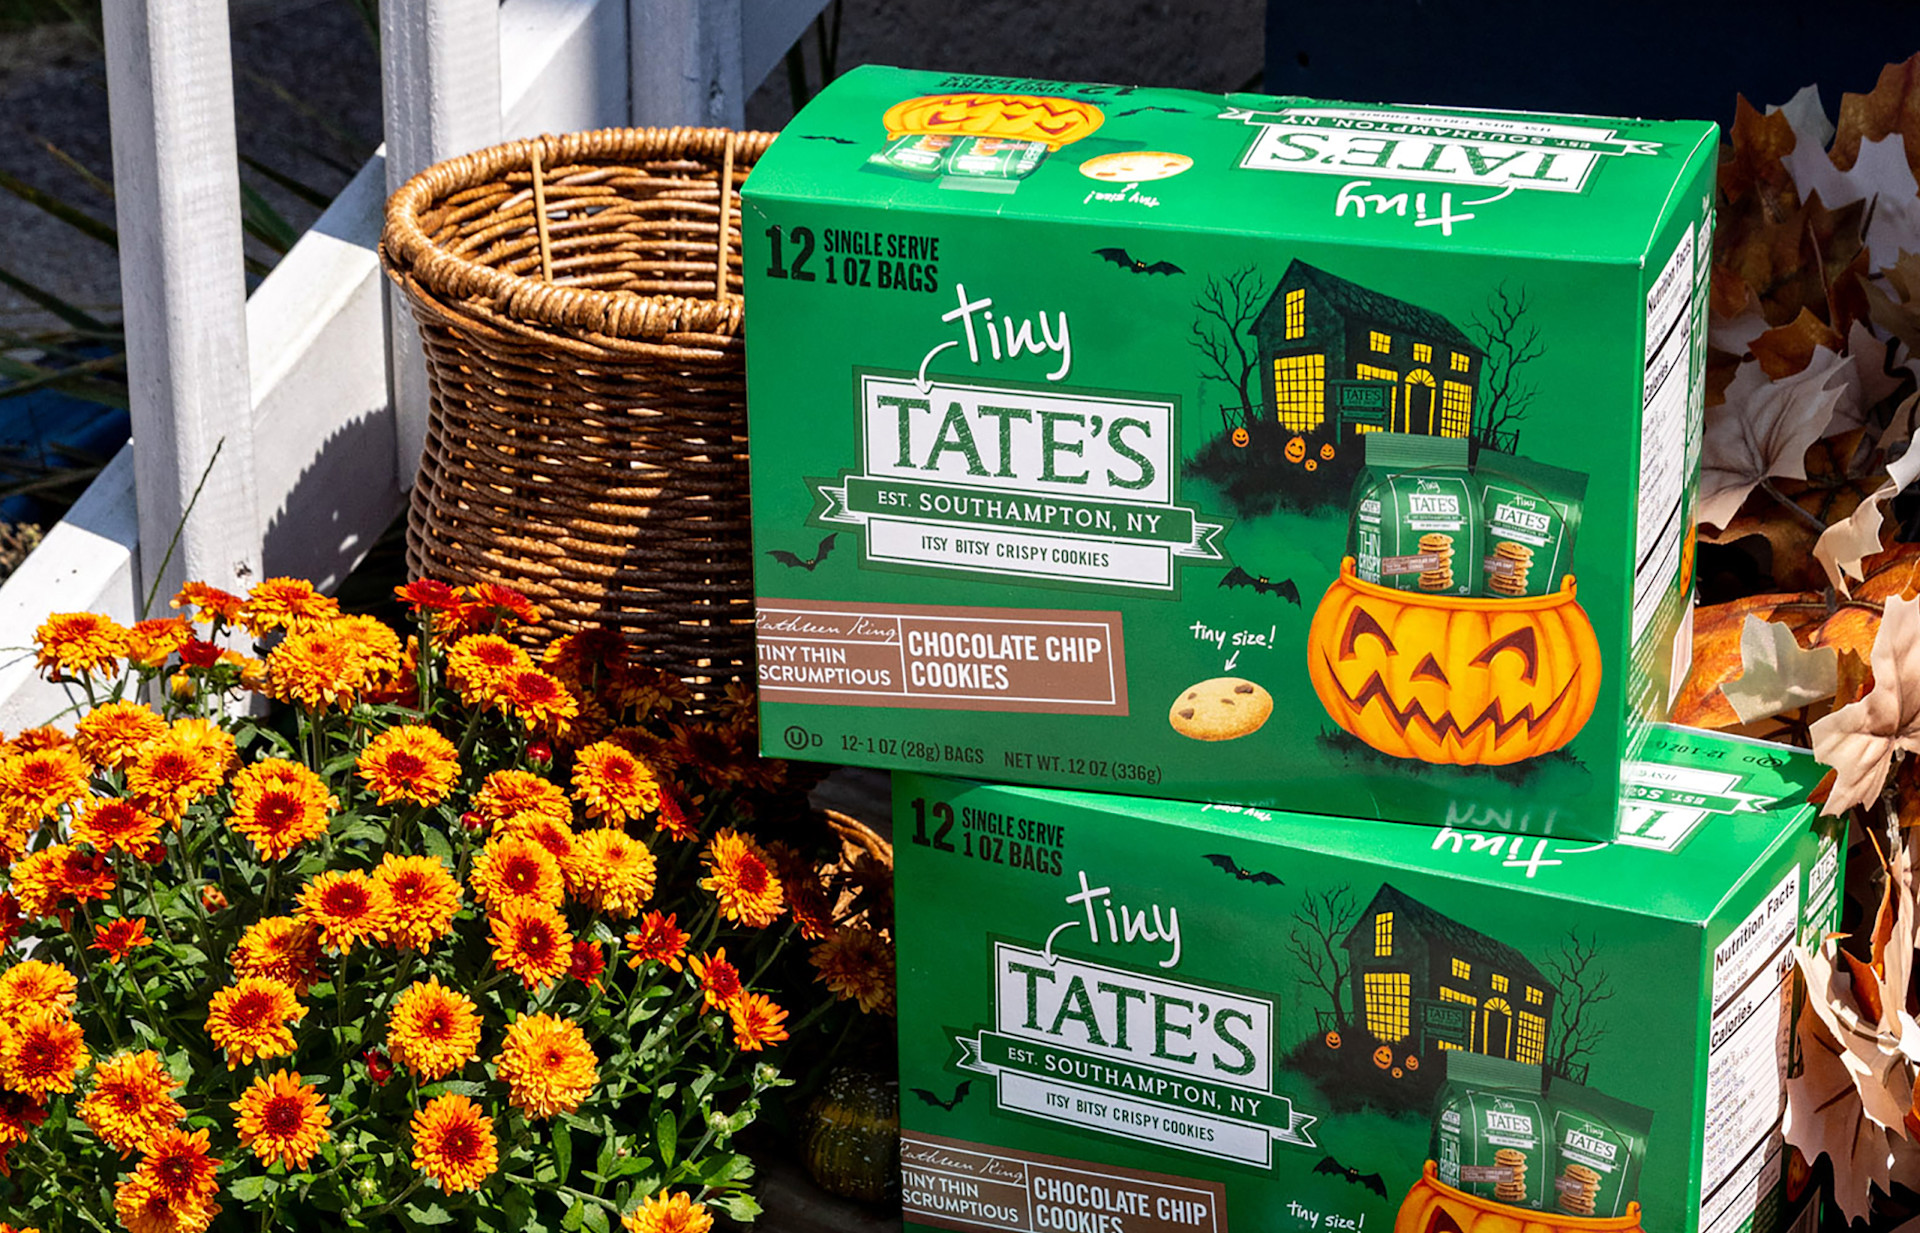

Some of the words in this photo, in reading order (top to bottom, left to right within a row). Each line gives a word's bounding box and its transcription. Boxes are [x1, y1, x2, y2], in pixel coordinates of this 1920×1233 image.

[1280, 114, 1321, 125] NY
[1331, 118, 1547, 147] SOUTHAMPTON,
[1272, 131, 1570, 184] TATE'S
[1553, 138, 1591, 150] EST.
[1335, 180, 1476, 237] tiny
[764, 225, 816, 282] 12
[824, 228, 883, 258] SINGLE
[887, 234, 940, 262] SERVE
[825, 257, 836, 284] 1
[843, 258, 871, 288] OZ
[878, 260, 938, 293] BAGS
[941, 283, 1073, 381] tiny
[877, 394, 1156, 490] TATE'S
[878, 491, 912, 508] EST.
[919, 493, 1117, 532] SOUTHAMPTON,
[1127, 512, 1162, 534] NY
[1411, 496, 1458, 513] TATE'S
[1499, 507, 1547, 530] TATE'S
[921, 535, 948, 553] ITSY
[955, 538, 990, 556] BITSY
[996, 543, 1048, 562] CRISPY
[1051, 547, 1110, 568] COOKIES
[847, 615, 897, 644] King
[907, 630, 1039, 661] CHOCOLATE
[1045, 636, 1102, 663] CHIP
[1189, 620, 1226, 650] tiny
[1232, 624, 1276, 649] size!
[757, 644, 797, 662] TINY
[800, 646, 846, 664] THIN
[758, 664, 891, 686] SCRUMPTIOUS
[910, 661, 1009, 690] COOKIES
[879, 738, 897, 755] OZ
[901, 740, 940, 762] (28g)
[944, 745, 984, 764] BAGS
[1004, 751, 1033, 769] NET
[1037, 755, 1065, 773] WT.
[1069, 758, 1085, 774] 12
[1089, 760, 1107, 777] OZ
[1111, 761, 1162, 784] (336g)
[1671, 792, 1706, 805] EST.
[910, 798, 955, 853] 12
[962, 807, 1014, 840] SINGLE
[1017, 819, 1064, 849] SERVE
[962, 831, 972, 857] 1
[979, 834, 1004, 865] OZ
[1009, 842, 1063, 877] BAGS
[1431, 827, 1563, 878] tiny
[1066, 870, 1180, 969] tiny
[1715, 913, 1764, 971] Nutrition
[1767, 880, 1795, 919] Facts
[1009, 961, 1256, 1077] TATE'S
[1712, 1001, 1752, 1048] Calories
[1008, 1046, 1038, 1066] EST.
[1044, 1053, 1222, 1111] SOUTHAMPTON,
[1230, 1094, 1261, 1117] NY
[1046, 1091, 1070, 1109] ITSY
[1076, 1098, 1107, 1118] BITSY
[1112, 1107, 1160, 1130] CRISPY
[1163, 1118, 1215, 1142] COOKIES
[1570, 1131, 1614, 1158] TATE'S
[901, 1170, 936, 1190] TINY
[939, 1177, 979, 1198] THIN
[1034, 1176, 1151, 1218] CHOCOLATE
[1157, 1196, 1208, 1226] CHIP
[902, 1188, 1019, 1223] SCRUMPTIOUS
[1036, 1203, 1124, 1233] COOKIES
[1286, 1200, 1319, 1229] tiny
[1325, 1212, 1365, 1233] size!
